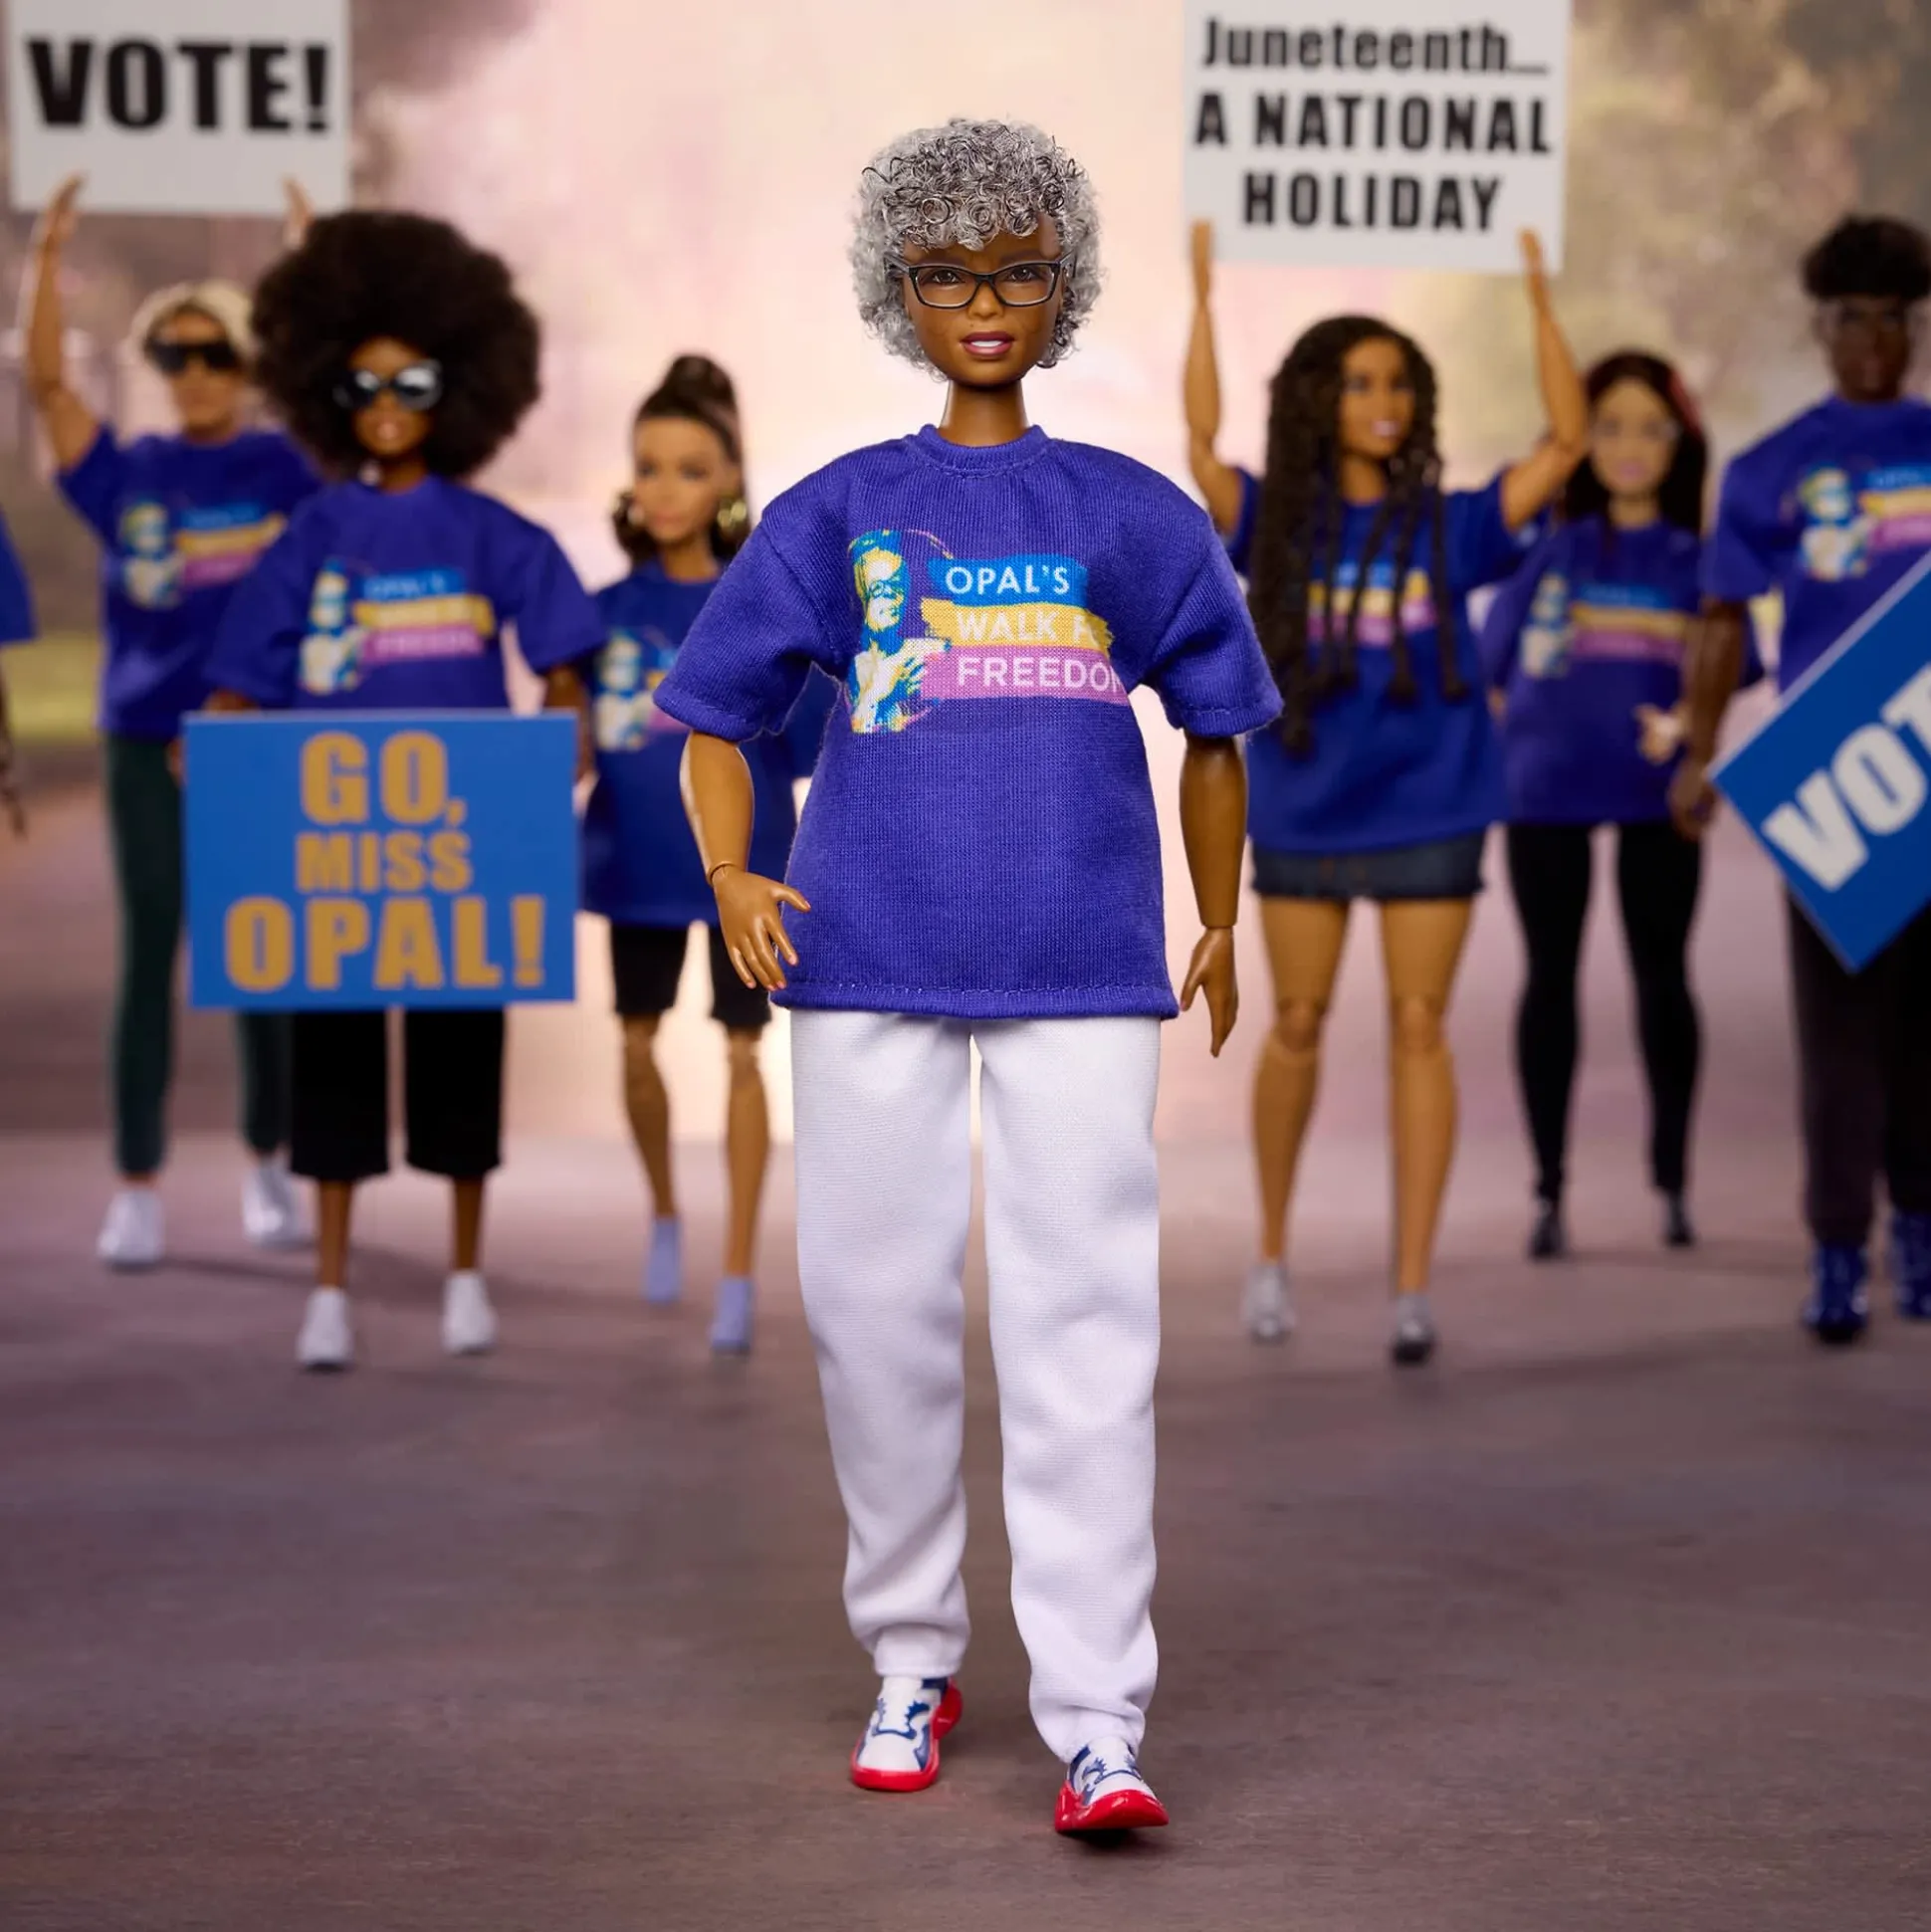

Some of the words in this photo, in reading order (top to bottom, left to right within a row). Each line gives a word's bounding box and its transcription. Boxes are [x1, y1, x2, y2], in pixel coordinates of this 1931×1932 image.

[26, 38, 330, 133] VOTE!
[1195, 92, 1226, 146] A
[1254, 94, 1550, 154] NATIONAL
[1243, 172, 1500, 231] HOLIDAY
[945, 564, 1070, 595] OPAL'S
[955, 609, 1059, 642] WALK
[300, 731, 468, 826] GO,
[296, 830, 473, 893] MISS
[224, 896, 545, 991] OPAL!
